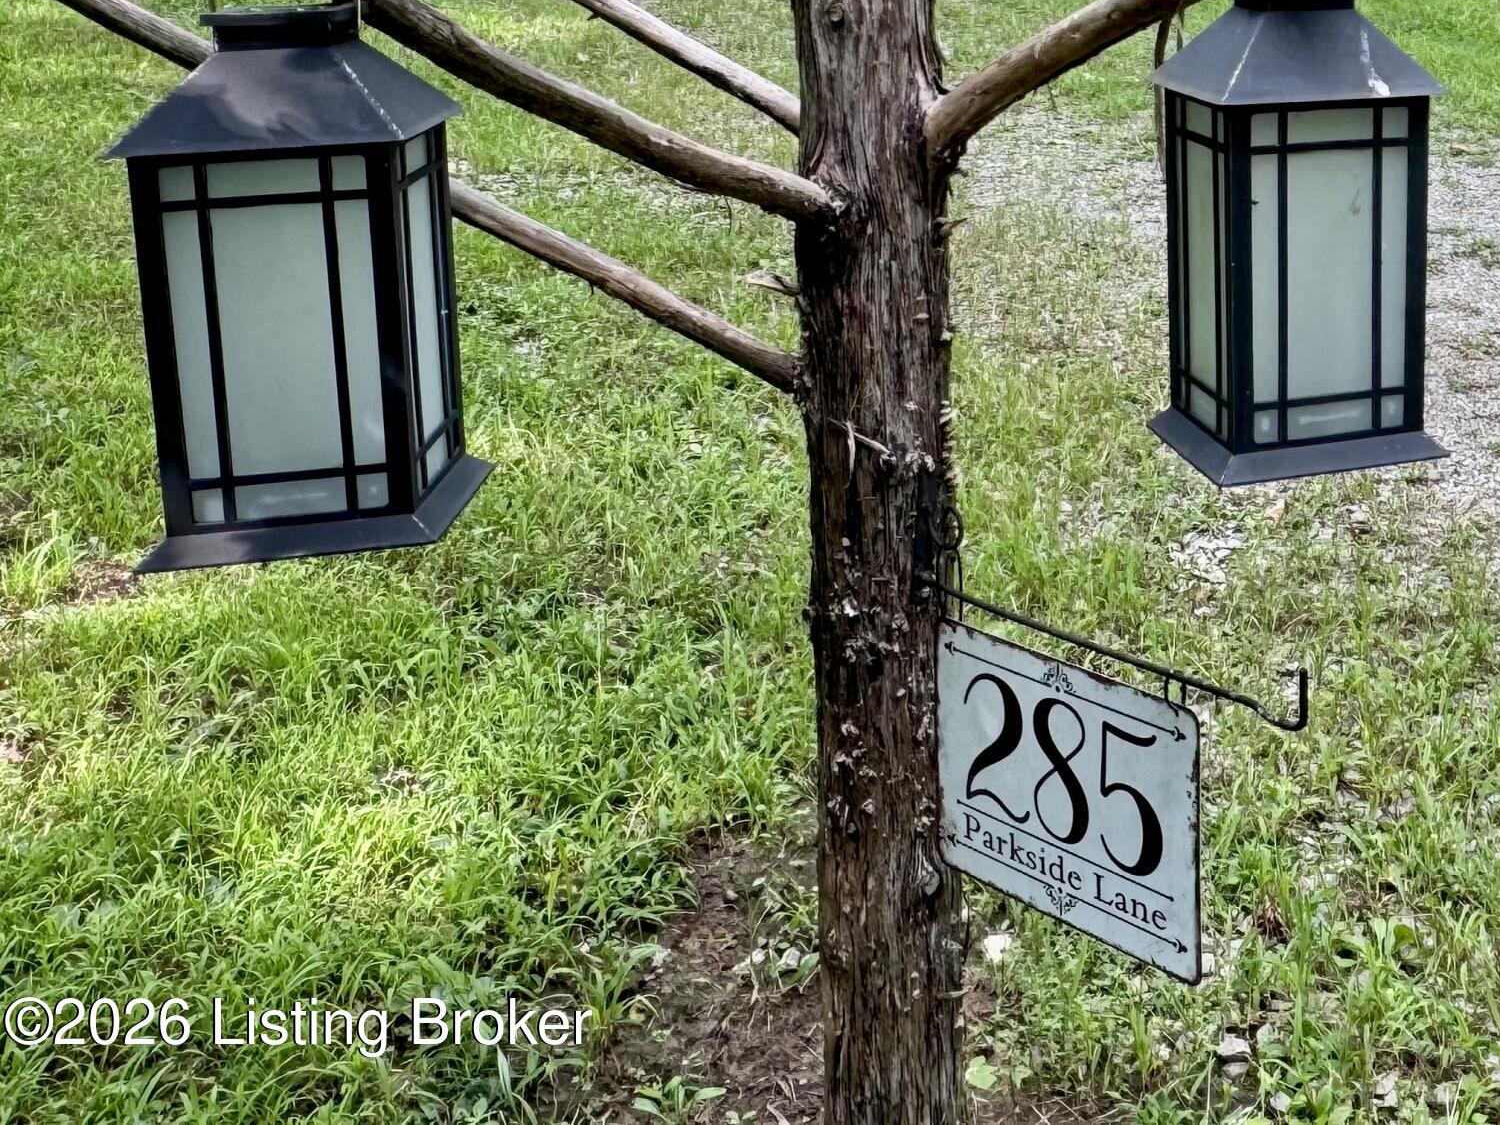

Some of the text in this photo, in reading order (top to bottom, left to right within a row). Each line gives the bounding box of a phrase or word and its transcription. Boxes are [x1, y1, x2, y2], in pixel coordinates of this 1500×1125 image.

[963, 672, 1164, 877] 285
[962, 812, 1167, 930] Parkside Lane
